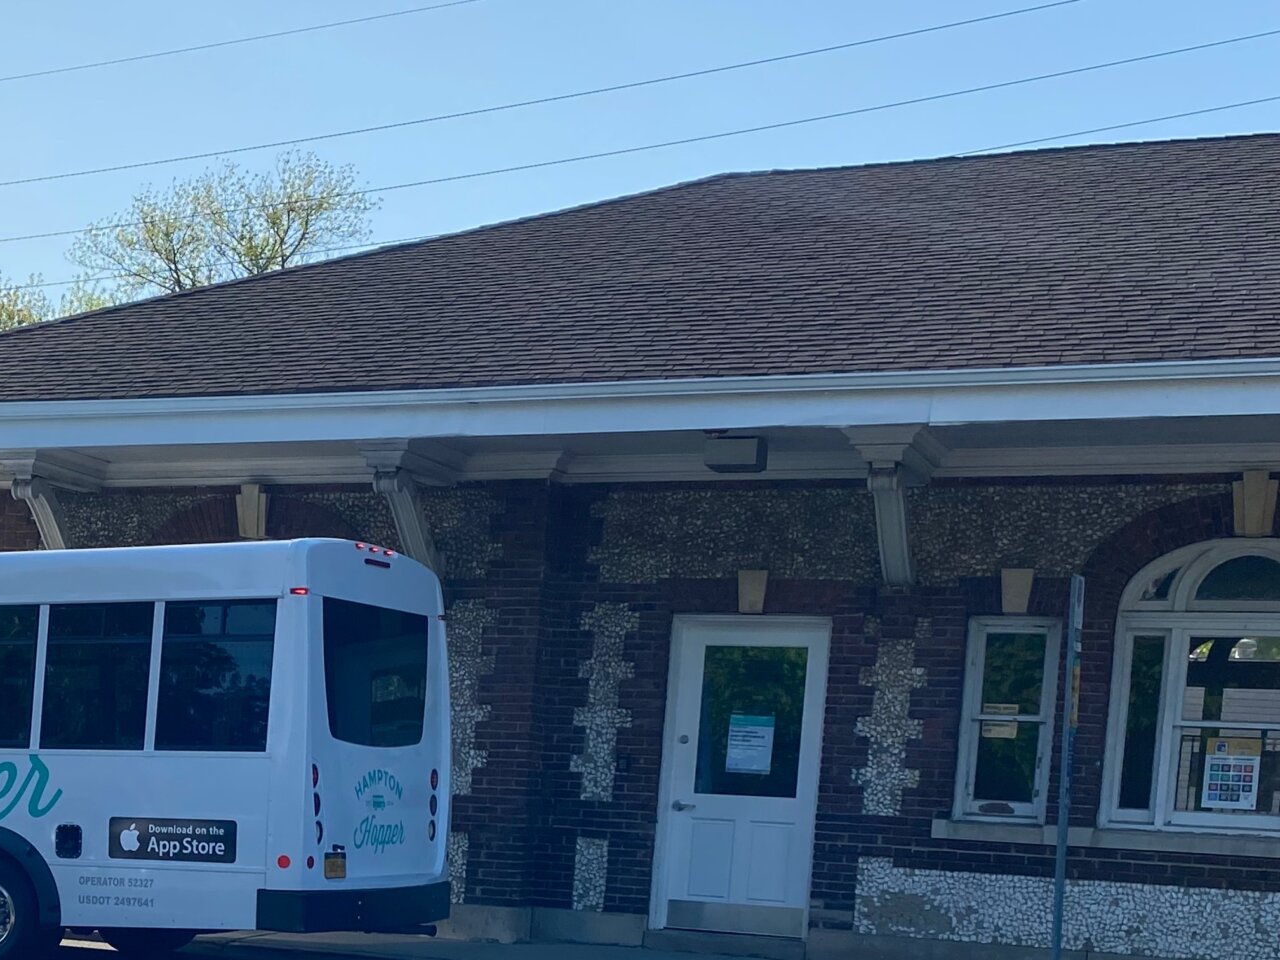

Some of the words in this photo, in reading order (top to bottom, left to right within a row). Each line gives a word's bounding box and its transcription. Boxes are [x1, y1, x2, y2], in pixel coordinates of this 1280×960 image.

[354, 769, 404, 800] HAMPTON
[148, 824, 193, 835] Download
[195, 826, 207, 835] on
[209, 826, 225, 836] the
[353, 815, 406, 854] Hopper
[147, 836, 180, 857] App
[182, 837, 226, 855] Store
[78, 876, 126, 887] OPERATOR
[128, 877, 154, 888] 52327
[78, 894, 112, 905] USDOT
[114, 895, 155, 907] 2497641
